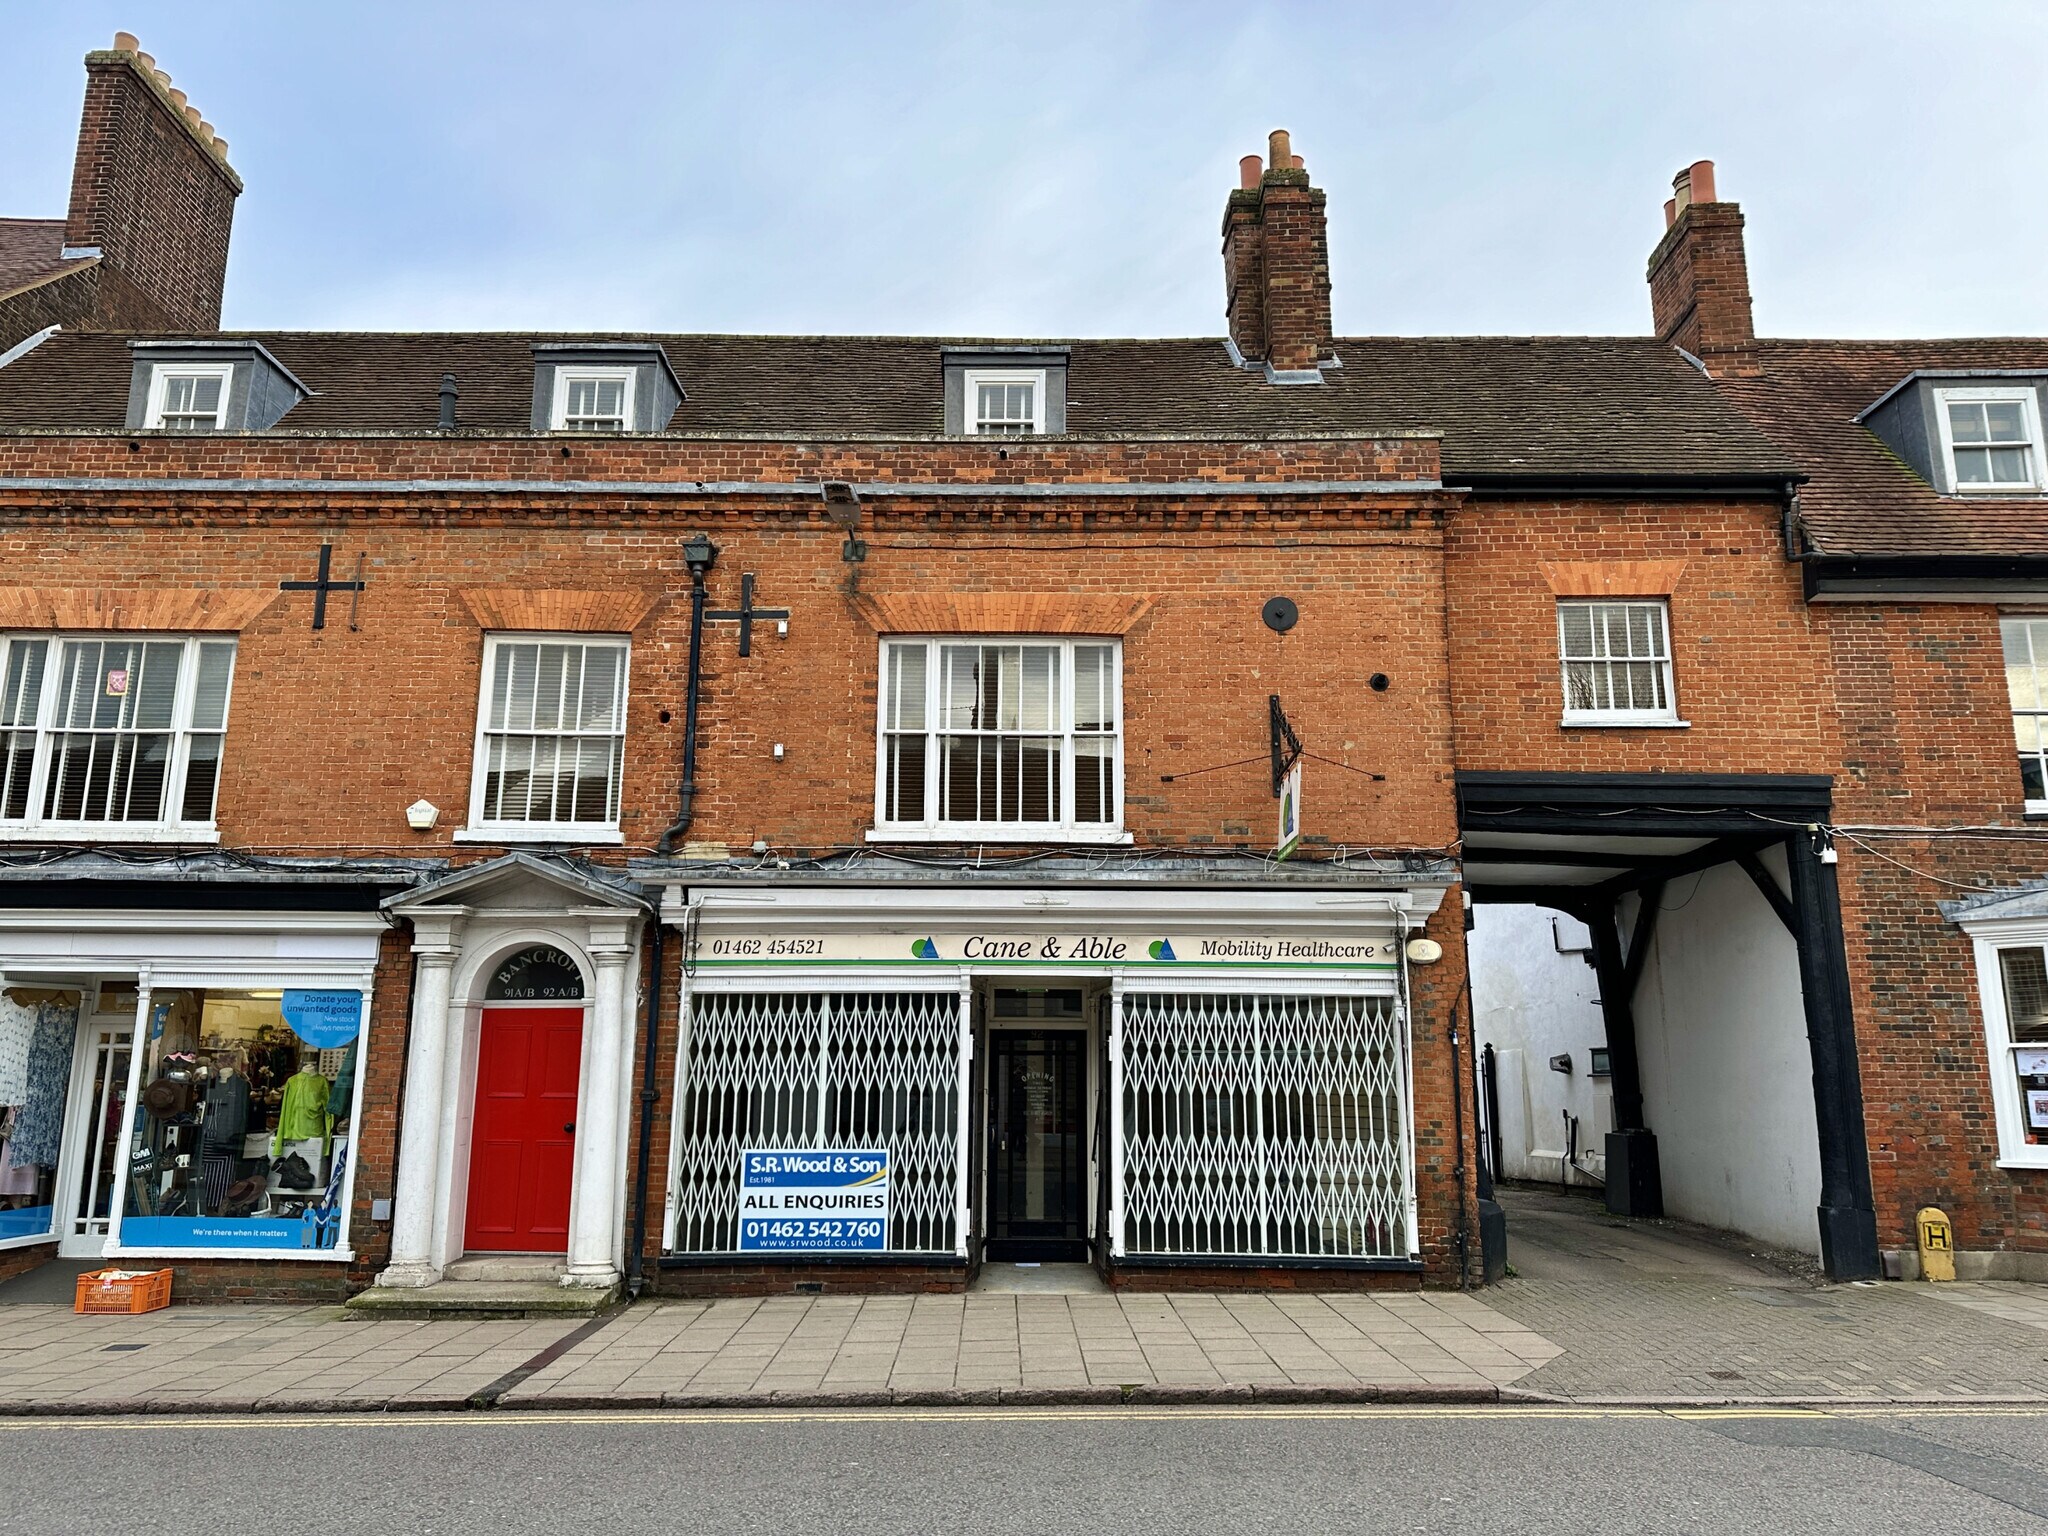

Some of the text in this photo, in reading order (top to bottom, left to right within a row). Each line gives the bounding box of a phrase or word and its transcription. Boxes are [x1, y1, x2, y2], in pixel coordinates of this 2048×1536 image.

[713, 936, 1375, 960] 01462 454521 Cane & Able Mobility Healthcare
[504, 987, 579, 998] 91A/B 92 A/B
[304, 994, 358, 1005] Donate your
[287, 1005, 358, 1015] unwanted goods
[1021, 1072, 1055, 1082] OPENING
[750, 1155, 881, 1173] S.R. Wood & Son
[744, 1195, 884, 1210] ALL ENQUIRIES
[192, 1228, 212, 1236] We're
[747, 1222, 880, 1237] 01462 542 760
[1927, 1225, 1947, 1248] H
[760, 1238, 864, 1247] www.srwood.co.uk
